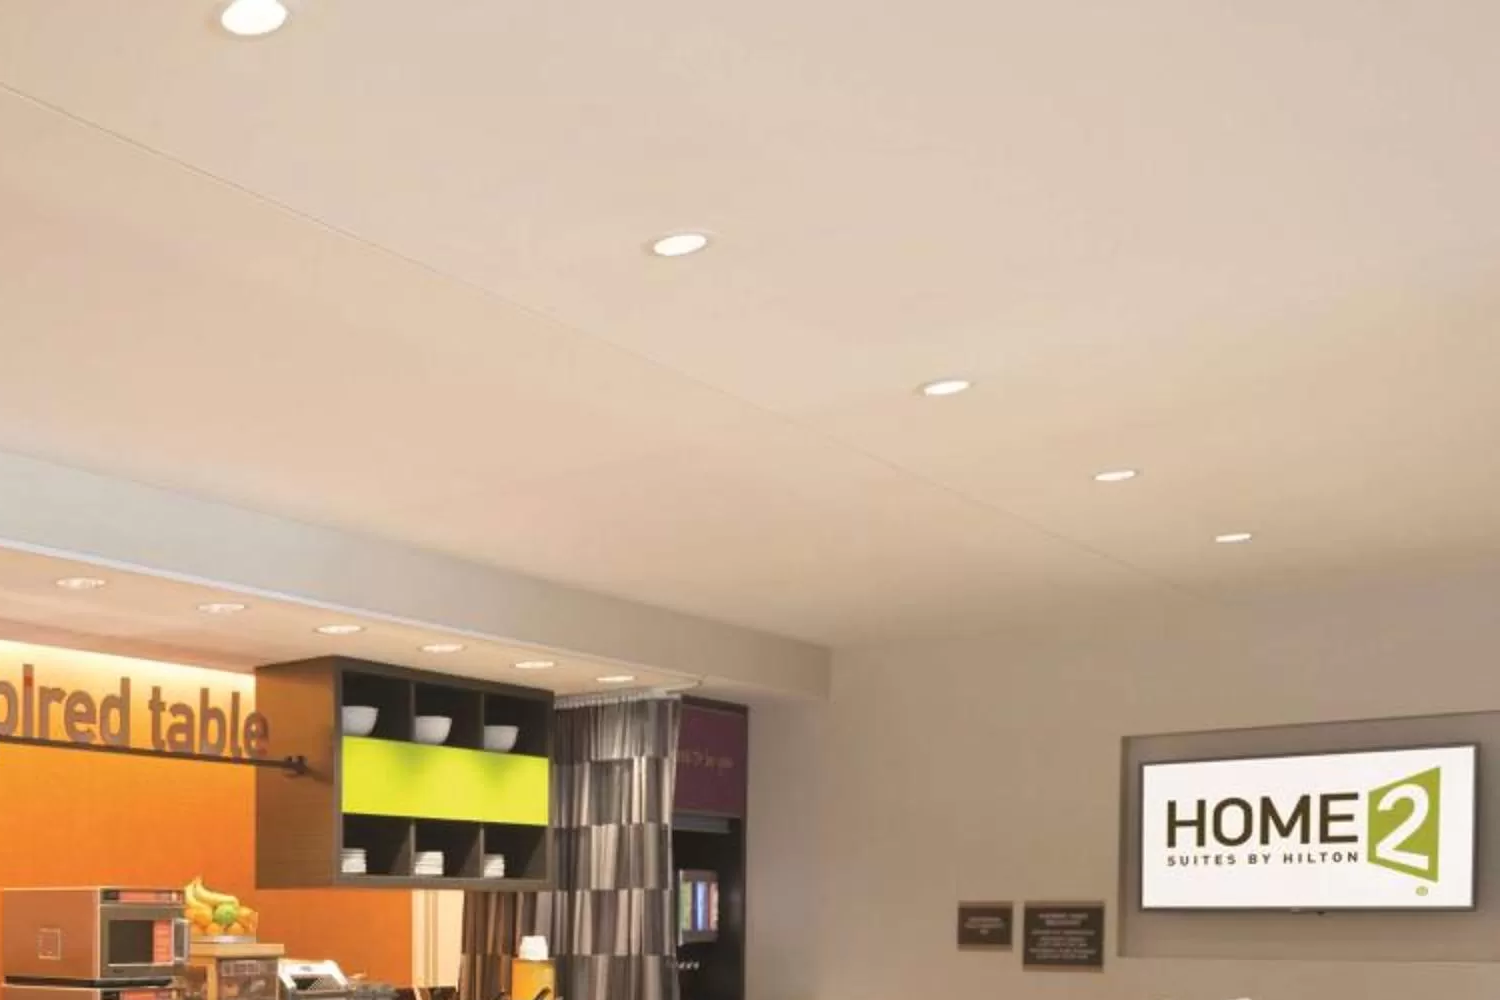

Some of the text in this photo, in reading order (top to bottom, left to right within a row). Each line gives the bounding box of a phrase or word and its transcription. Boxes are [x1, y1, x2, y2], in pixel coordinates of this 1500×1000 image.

[149, 686, 269, 760] table
[1167, 782, 1431, 872] HOME 2
[1167, 851, 1359, 867] SUITES BY HILTON
